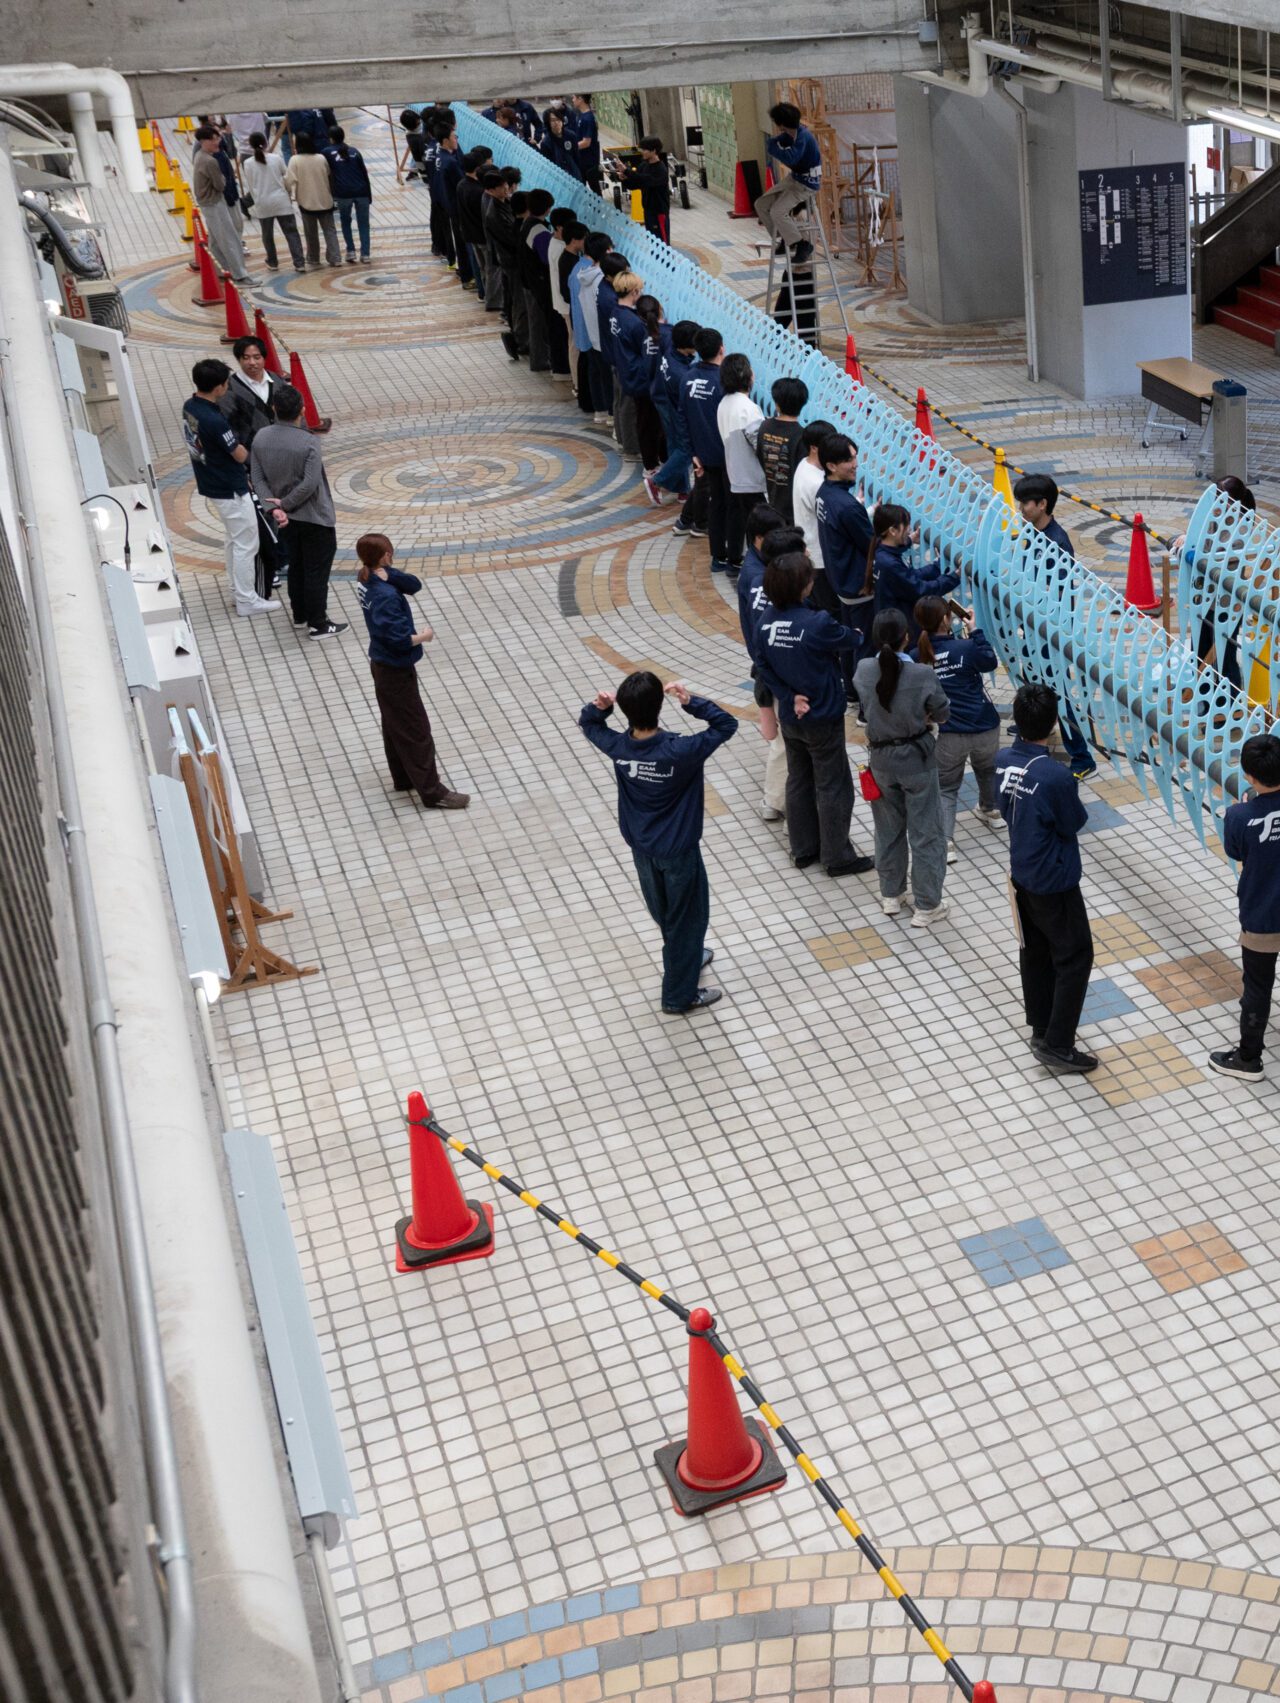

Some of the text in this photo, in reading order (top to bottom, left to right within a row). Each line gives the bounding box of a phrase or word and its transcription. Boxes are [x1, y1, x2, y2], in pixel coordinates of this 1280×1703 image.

[1098, 174, 1104, 188] 2
[1135, 175, 1141, 185] 3
[1152, 174, 1157, 183] 4
[1169, 172, 1174, 182] 5
